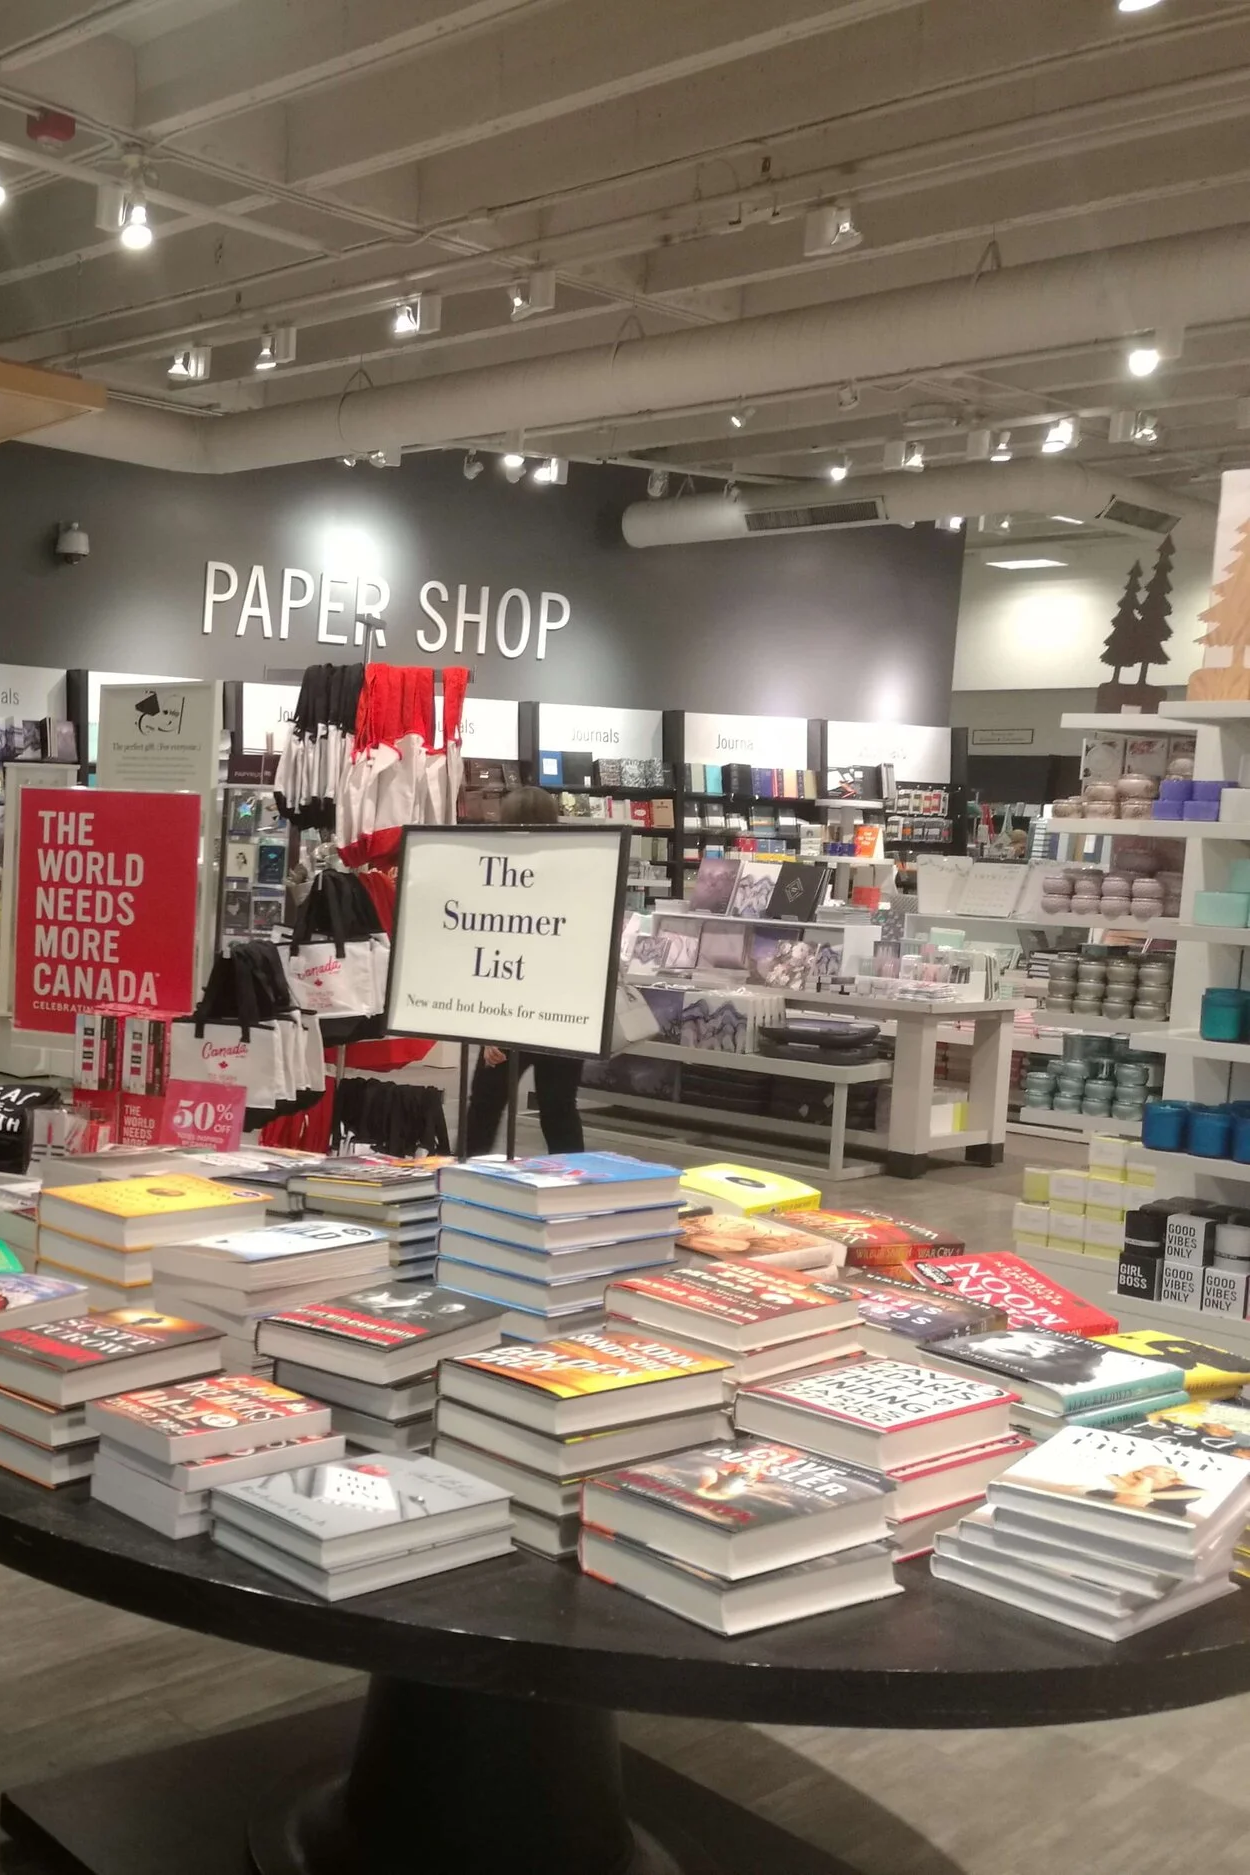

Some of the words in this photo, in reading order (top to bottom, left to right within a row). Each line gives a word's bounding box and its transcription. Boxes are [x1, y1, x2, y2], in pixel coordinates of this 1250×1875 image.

[202, 561, 390, 648] PAPER
[416, 580, 572, 661] SHOP
[571, 727, 620, 744] Journals
[38, 810, 94, 847] THE
[37, 849, 144, 888] WORLD
[478, 855, 536, 889] The
[35, 888, 136, 927] NEEDS
[443, 900, 567, 940] Summer
[35, 924, 120, 964] MORE
[471, 945, 526, 982] List
[33, 962, 157, 1006] CANADA
[406, 993, 429, 1008] New
[431, 998, 453, 1011] and
[456, 998, 475, 1013] hot
[478, 1001, 513, 1018] books
[517, 1004, 536, 1020] for
[538, 1011, 590, 1025] summer
[202, 1041, 248, 1060] Canada
[124, 1104, 142, 1115] THE
[124, 1115, 155, 1129] WORLD
[123, 1128, 153, 1140] NEEDS
[213, 1123, 233, 1133] OFF
[1167, 1235, 1197, 1249] VIBES
[1168, 1223, 1196, 1238] GOOD
[1166, 1245, 1193, 1259] ONLY
[671, 1268, 755, 1294] Moon
[1119, 1275, 1148, 1290] BOSS
[1120, 1263, 1143, 1278] GIRL
[1164, 1267, 1194, 1282] GOOD
[1206, 1275, 1236, 1290] GOOD
[1163, 1289, 1190, 1303] ONLY
[1164, 1278, 1195, 1293] VIBES
[1205, 1287, 1238, 1302] VIBES
[1204, 1298, 1232, 1312] ONLY
[26, 1323, 137, 1355] TUROW
[59, 1317, 157, 1347] SCOTT
[453, 1352, 568, 1374] PREY
[490, 1346, 643, 1379] GOLDEN
[566, 1332, 673, 1373] SANDFORD
[628, 1340, 703, 1368] JOHN
[812, 1374, 931, 1415] FINDING
[832, 1369, 933, 1398] THEFT
[856, 1364, 980, 1401] SEDARIS
[176, 1381, 288, 1422] DREAMERS
[702, 1447, 848, 1498] CUSSLER
[745, 1448, 848, 1484] CLIVE
